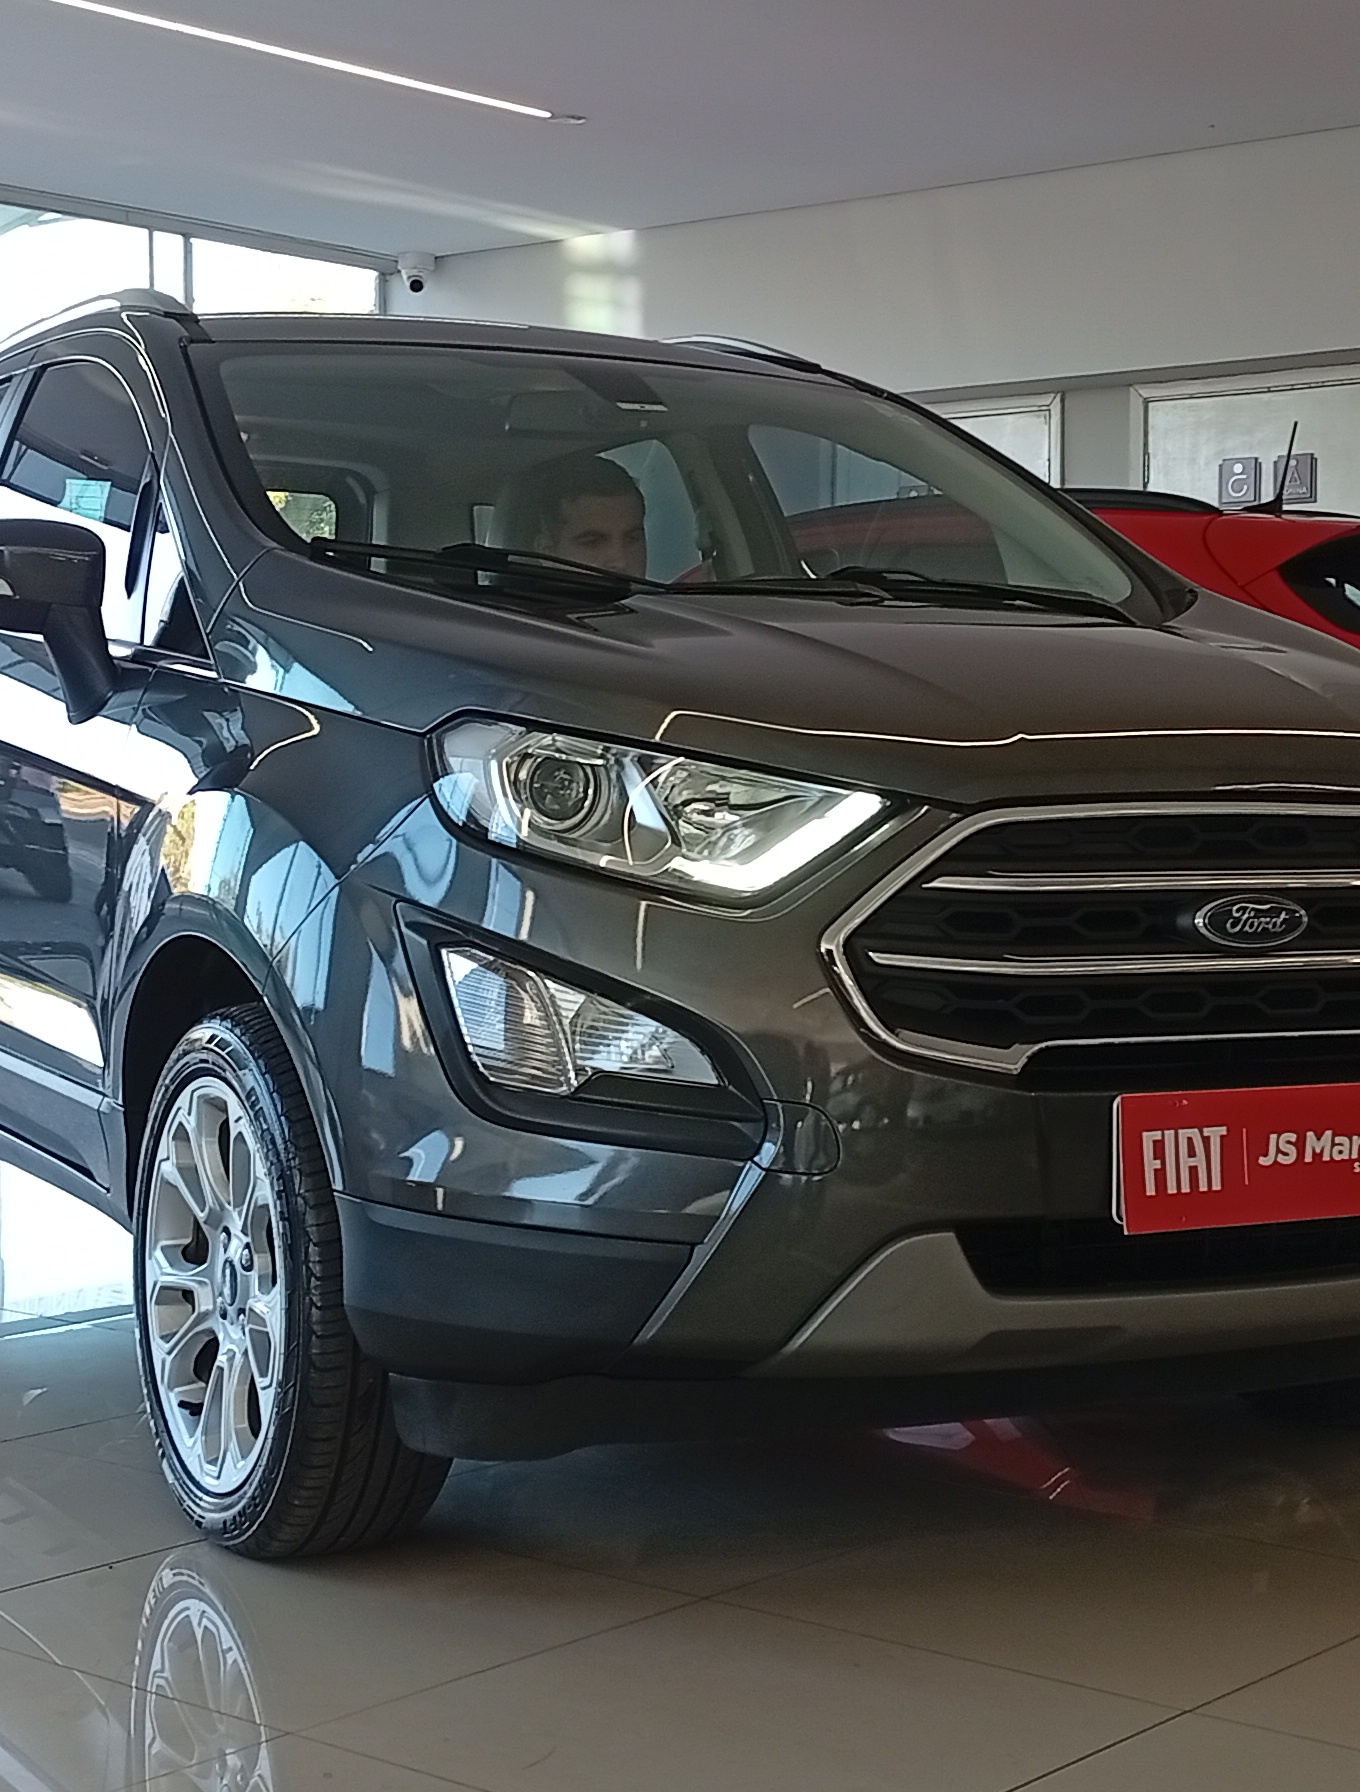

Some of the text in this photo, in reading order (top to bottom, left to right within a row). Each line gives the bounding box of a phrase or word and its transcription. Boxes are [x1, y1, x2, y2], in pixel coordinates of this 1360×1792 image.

[1226, 902, 1291, 934] Ford
[1142, 1126, 1227, 1196] FIAT
[1258, 1132, 1297, 1166] JS
